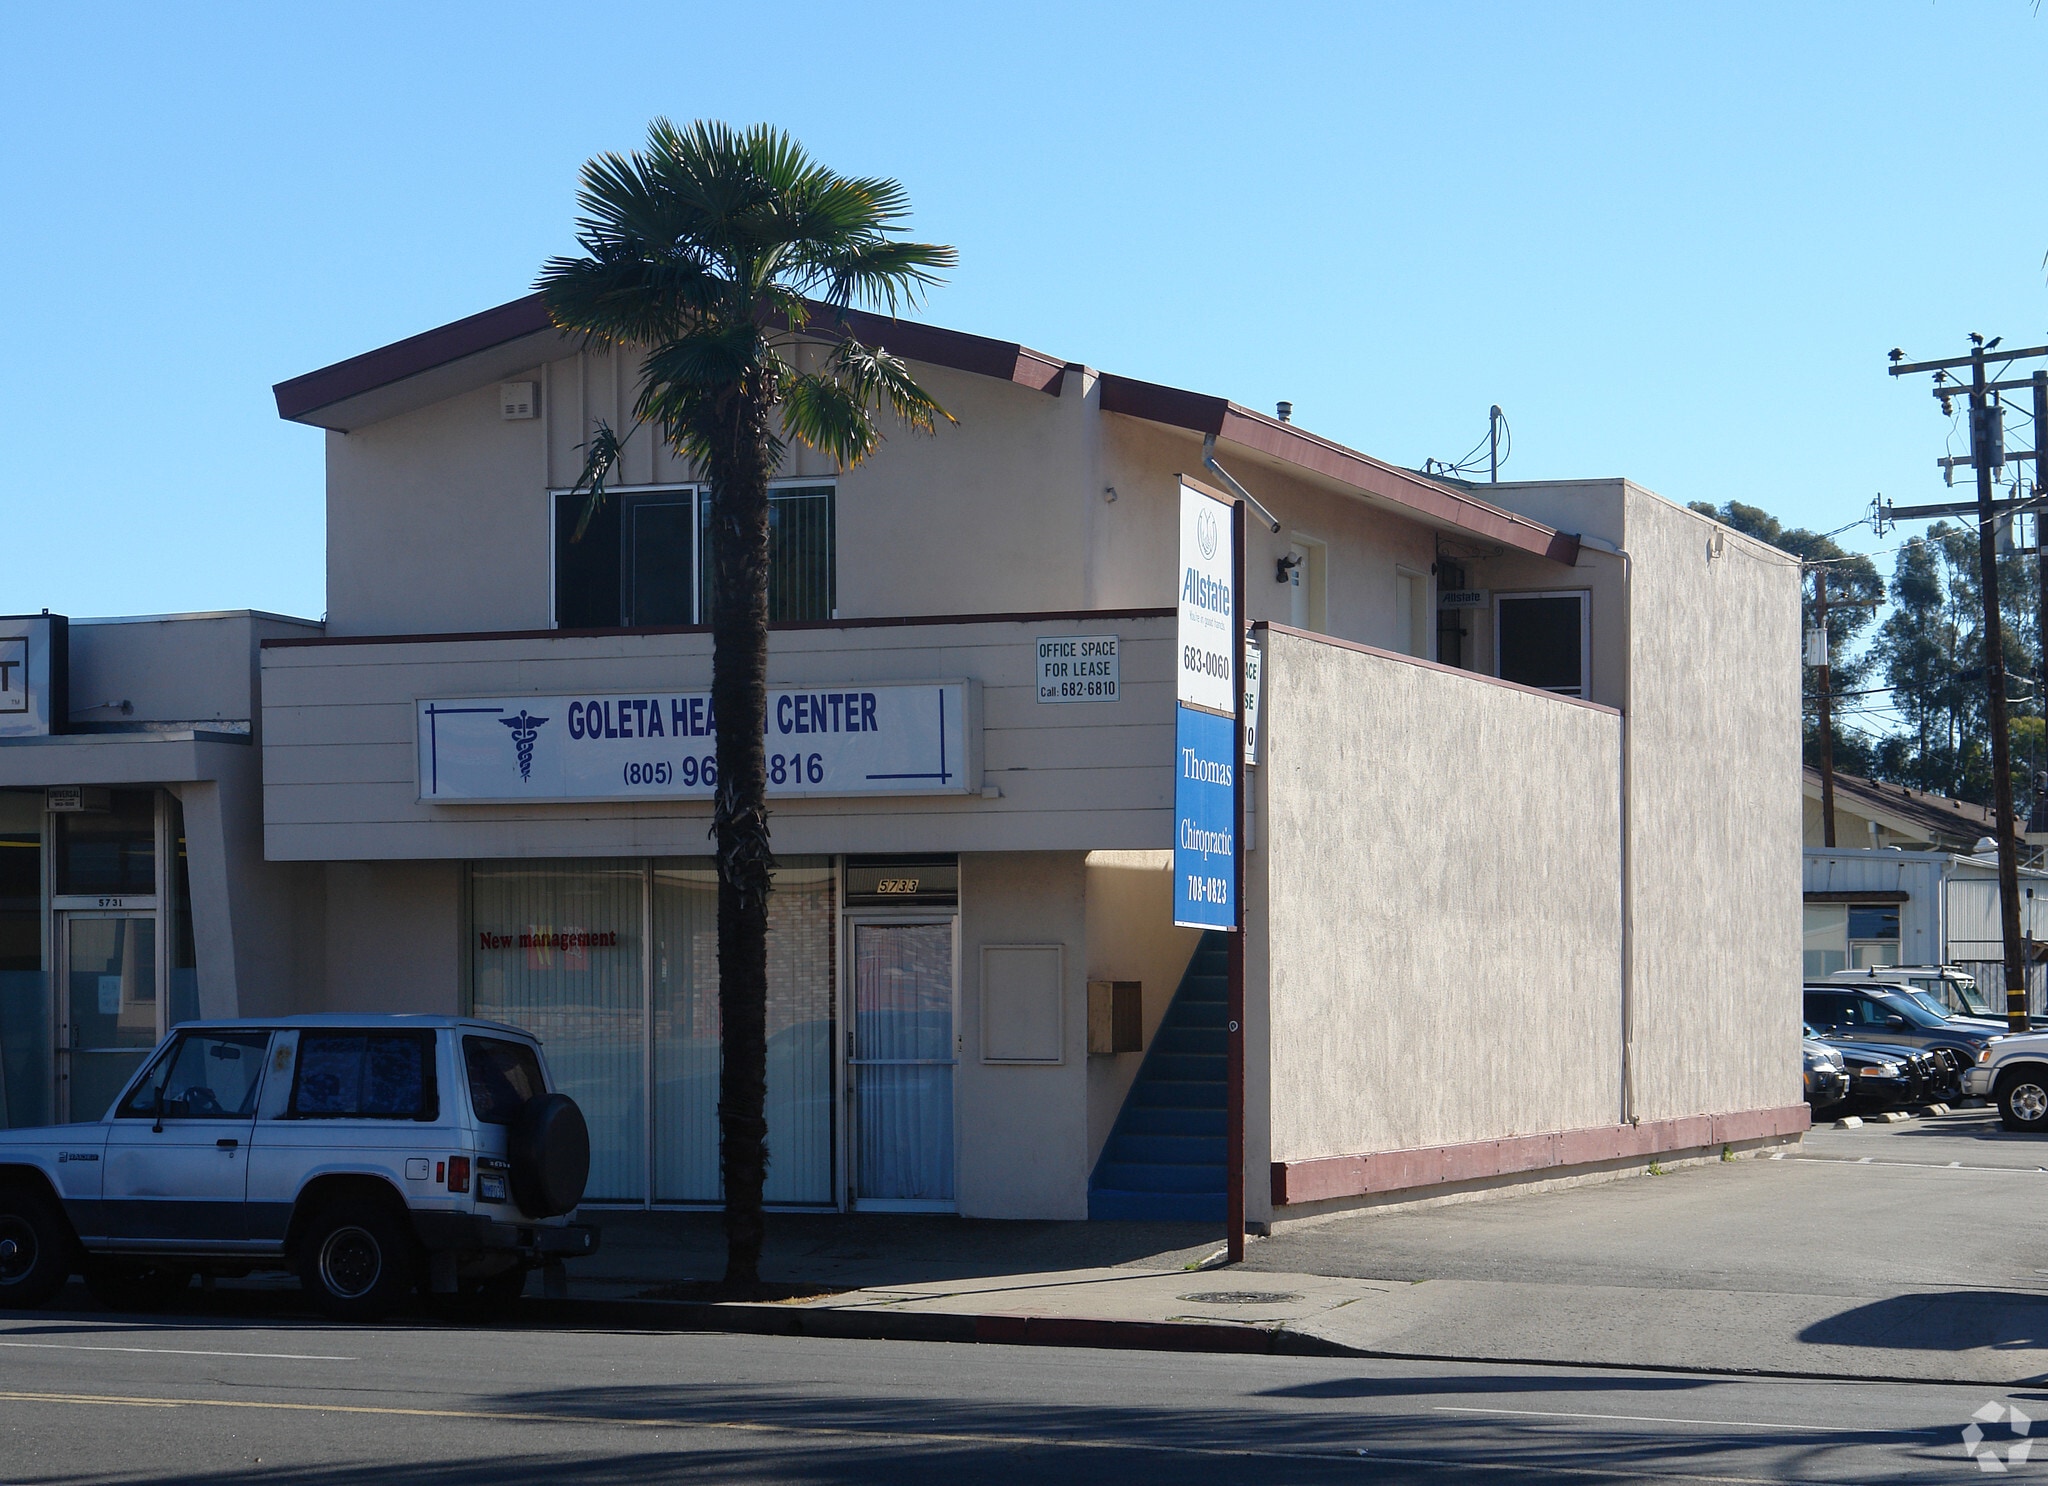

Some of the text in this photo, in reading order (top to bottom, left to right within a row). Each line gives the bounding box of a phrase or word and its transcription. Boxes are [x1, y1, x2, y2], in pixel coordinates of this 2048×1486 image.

[1182, 567, 1230, 617] Allstate
[1442, 592, 1481, 603] Allstate
[1039, 641, 1116, 658] OFFICE SPACE
[1045, 661, 1111, 678] FOR LEASE
[1184, 644, 1230, 681] 683-0060
[1040, 680, 1116, 697] Call: 682-6810
[568, 691, 878, 740] GOLETA HEA CENTER
[623, 759, 673, 786] (805)
[1182, 747, 1232, 787] Thomas
[1181, 817, 1232, 861] Chiropractic
[879, 880, 917, 892] 5733
[1188, 875, 1227, 905] 708-0823
[98, 897, 123, 907] 5731
[480, 930, 617, 951] New management
